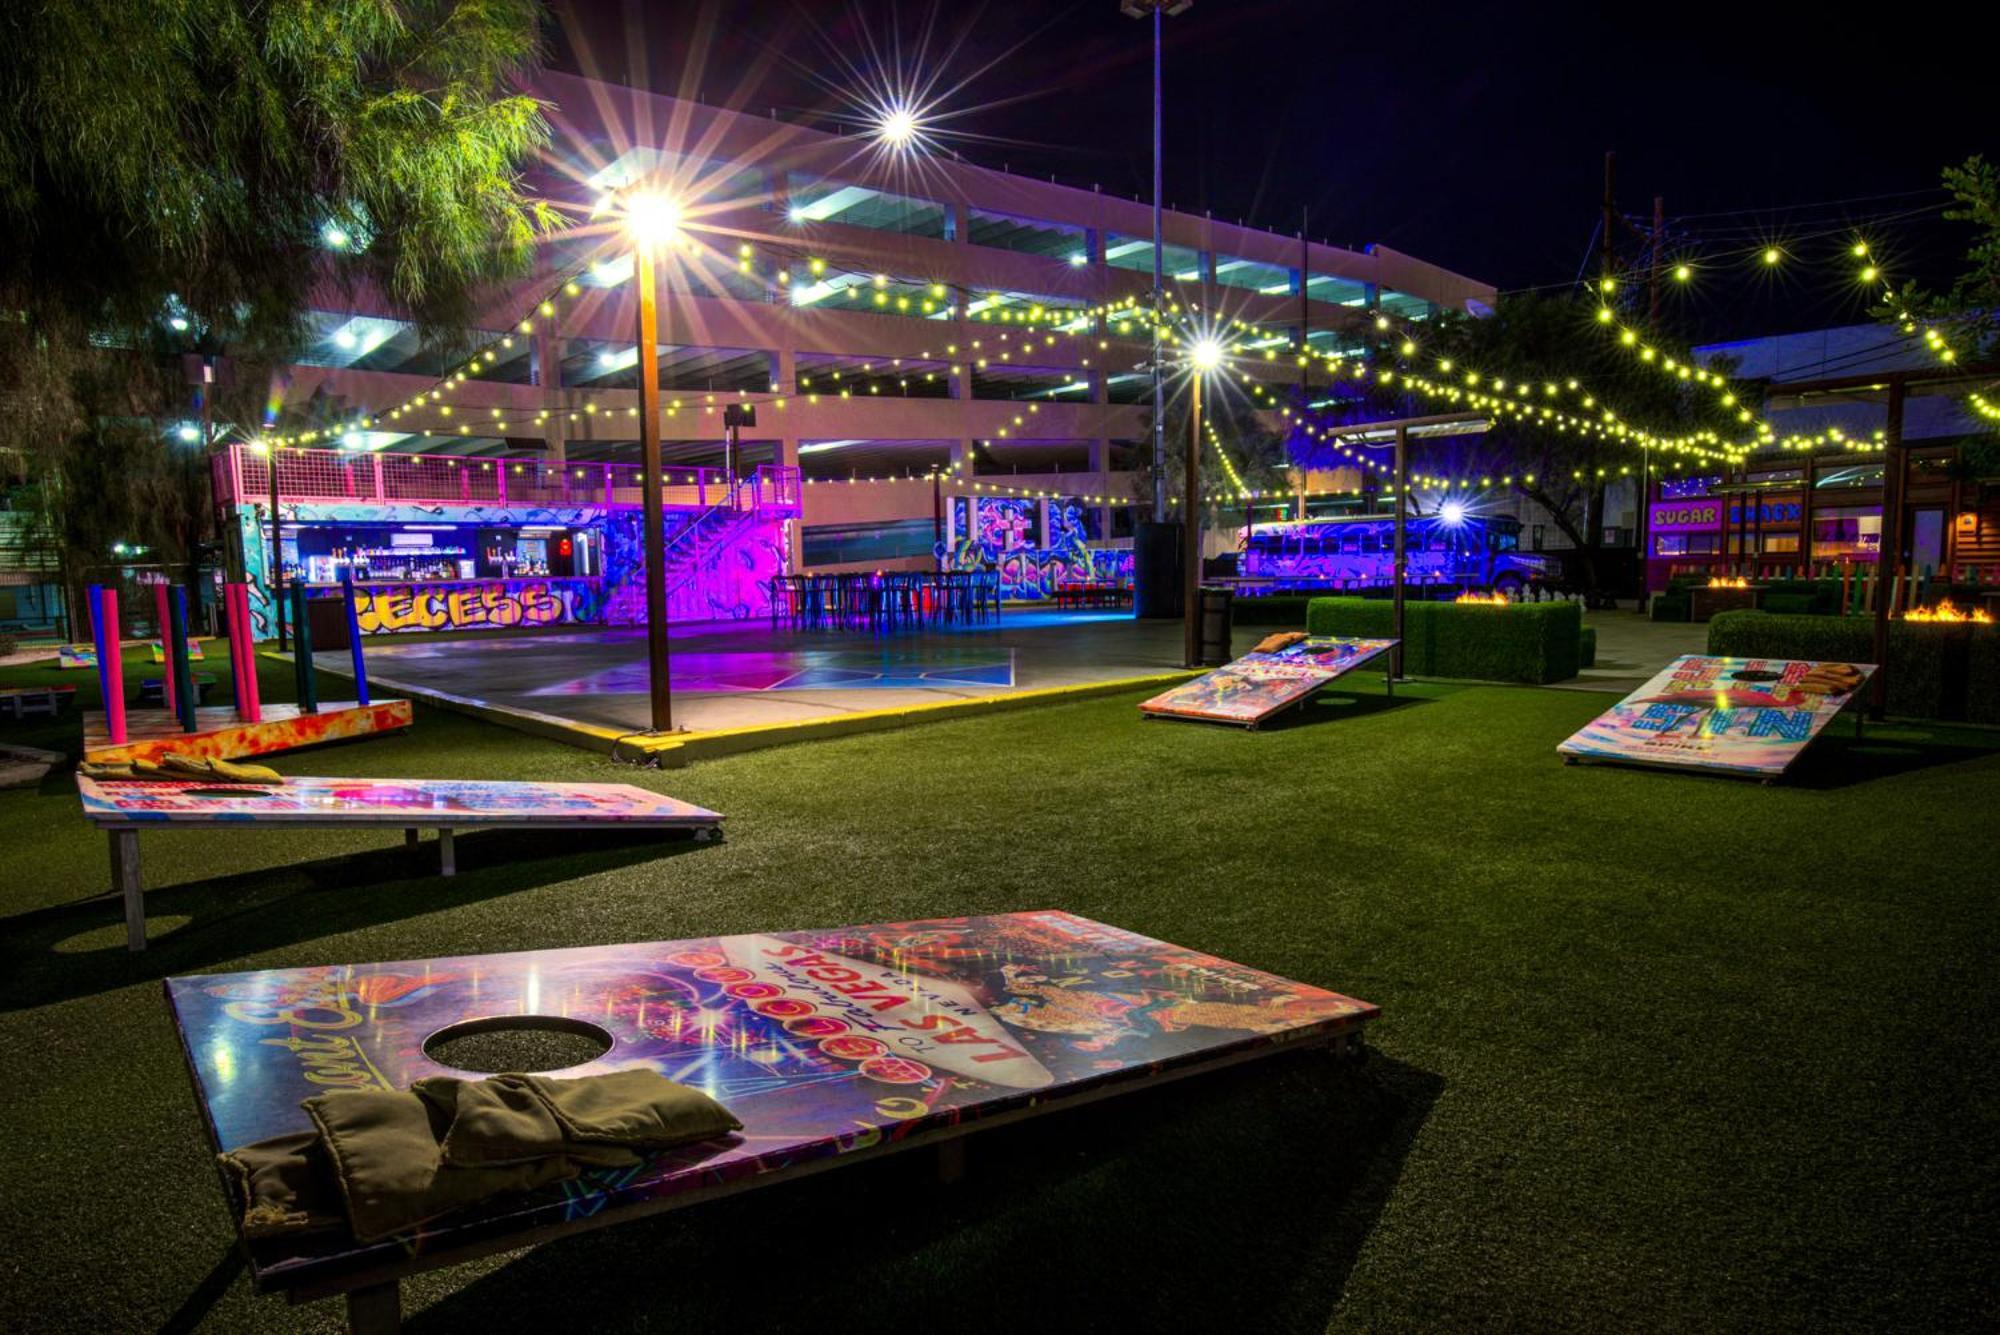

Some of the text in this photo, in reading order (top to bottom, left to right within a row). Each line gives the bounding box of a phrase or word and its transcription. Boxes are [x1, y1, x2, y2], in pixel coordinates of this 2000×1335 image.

[1655, 507, 1715, 525] SUGAR
[678, 953, 918, 1081] WELCOME
[761, 944, 1031, 1064] LAS VEGAS
[765, 961, 936, 1054] TO Fabulous
[881, 971, 978, 1016] NEVADA
